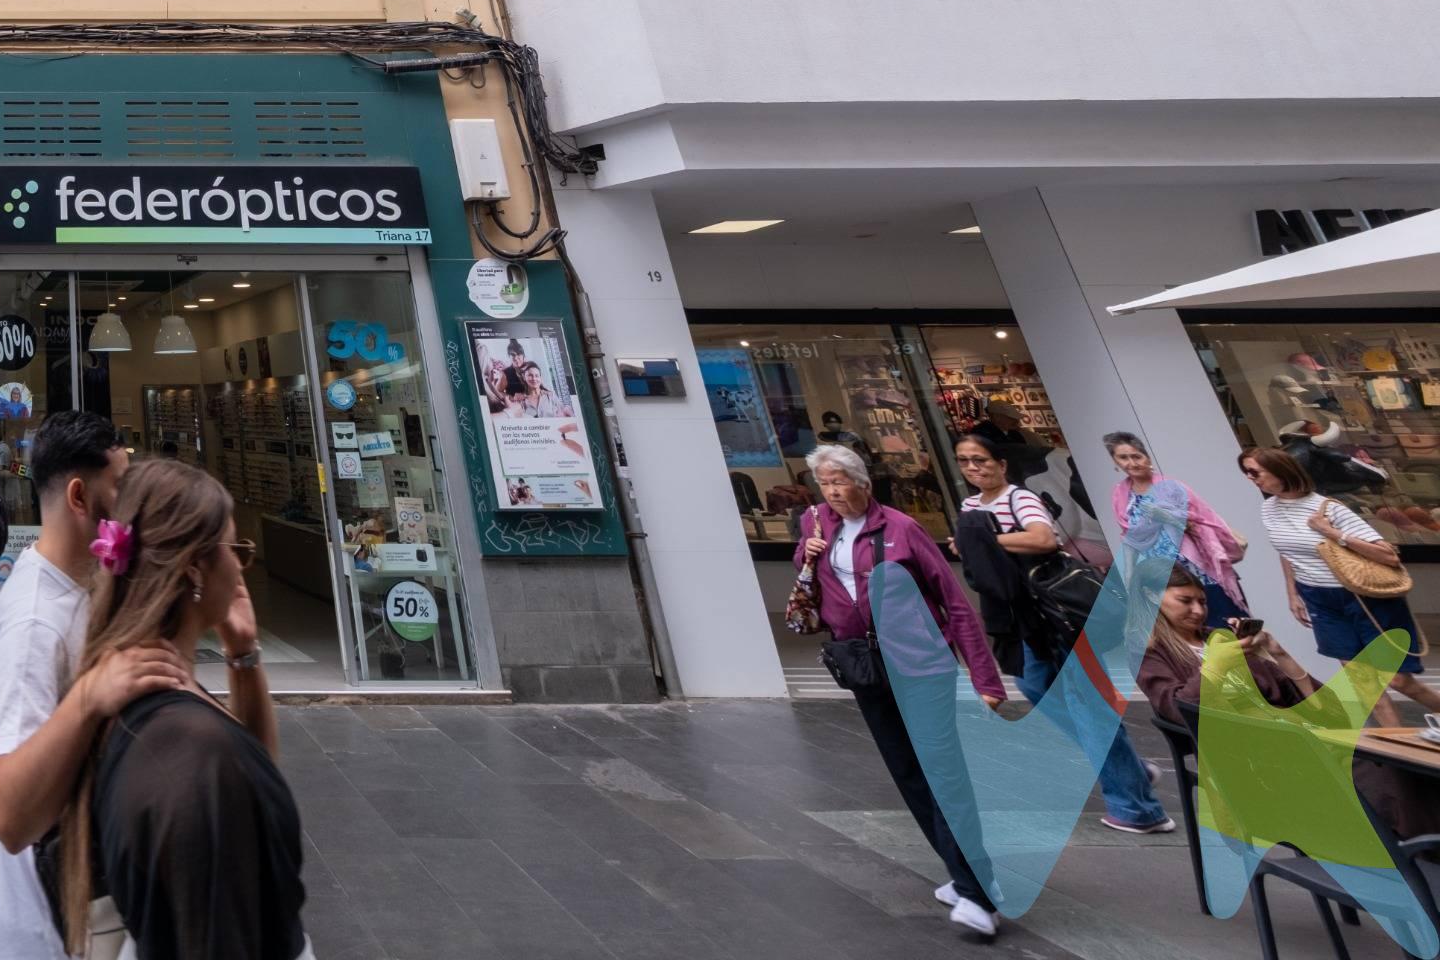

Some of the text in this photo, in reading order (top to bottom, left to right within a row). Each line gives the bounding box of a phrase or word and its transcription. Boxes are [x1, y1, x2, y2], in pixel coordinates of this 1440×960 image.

[55, 174, 402, 232] federópticos
[375, 230, 429, 241] Triana 17
[647, 270, 663, 283] 19
